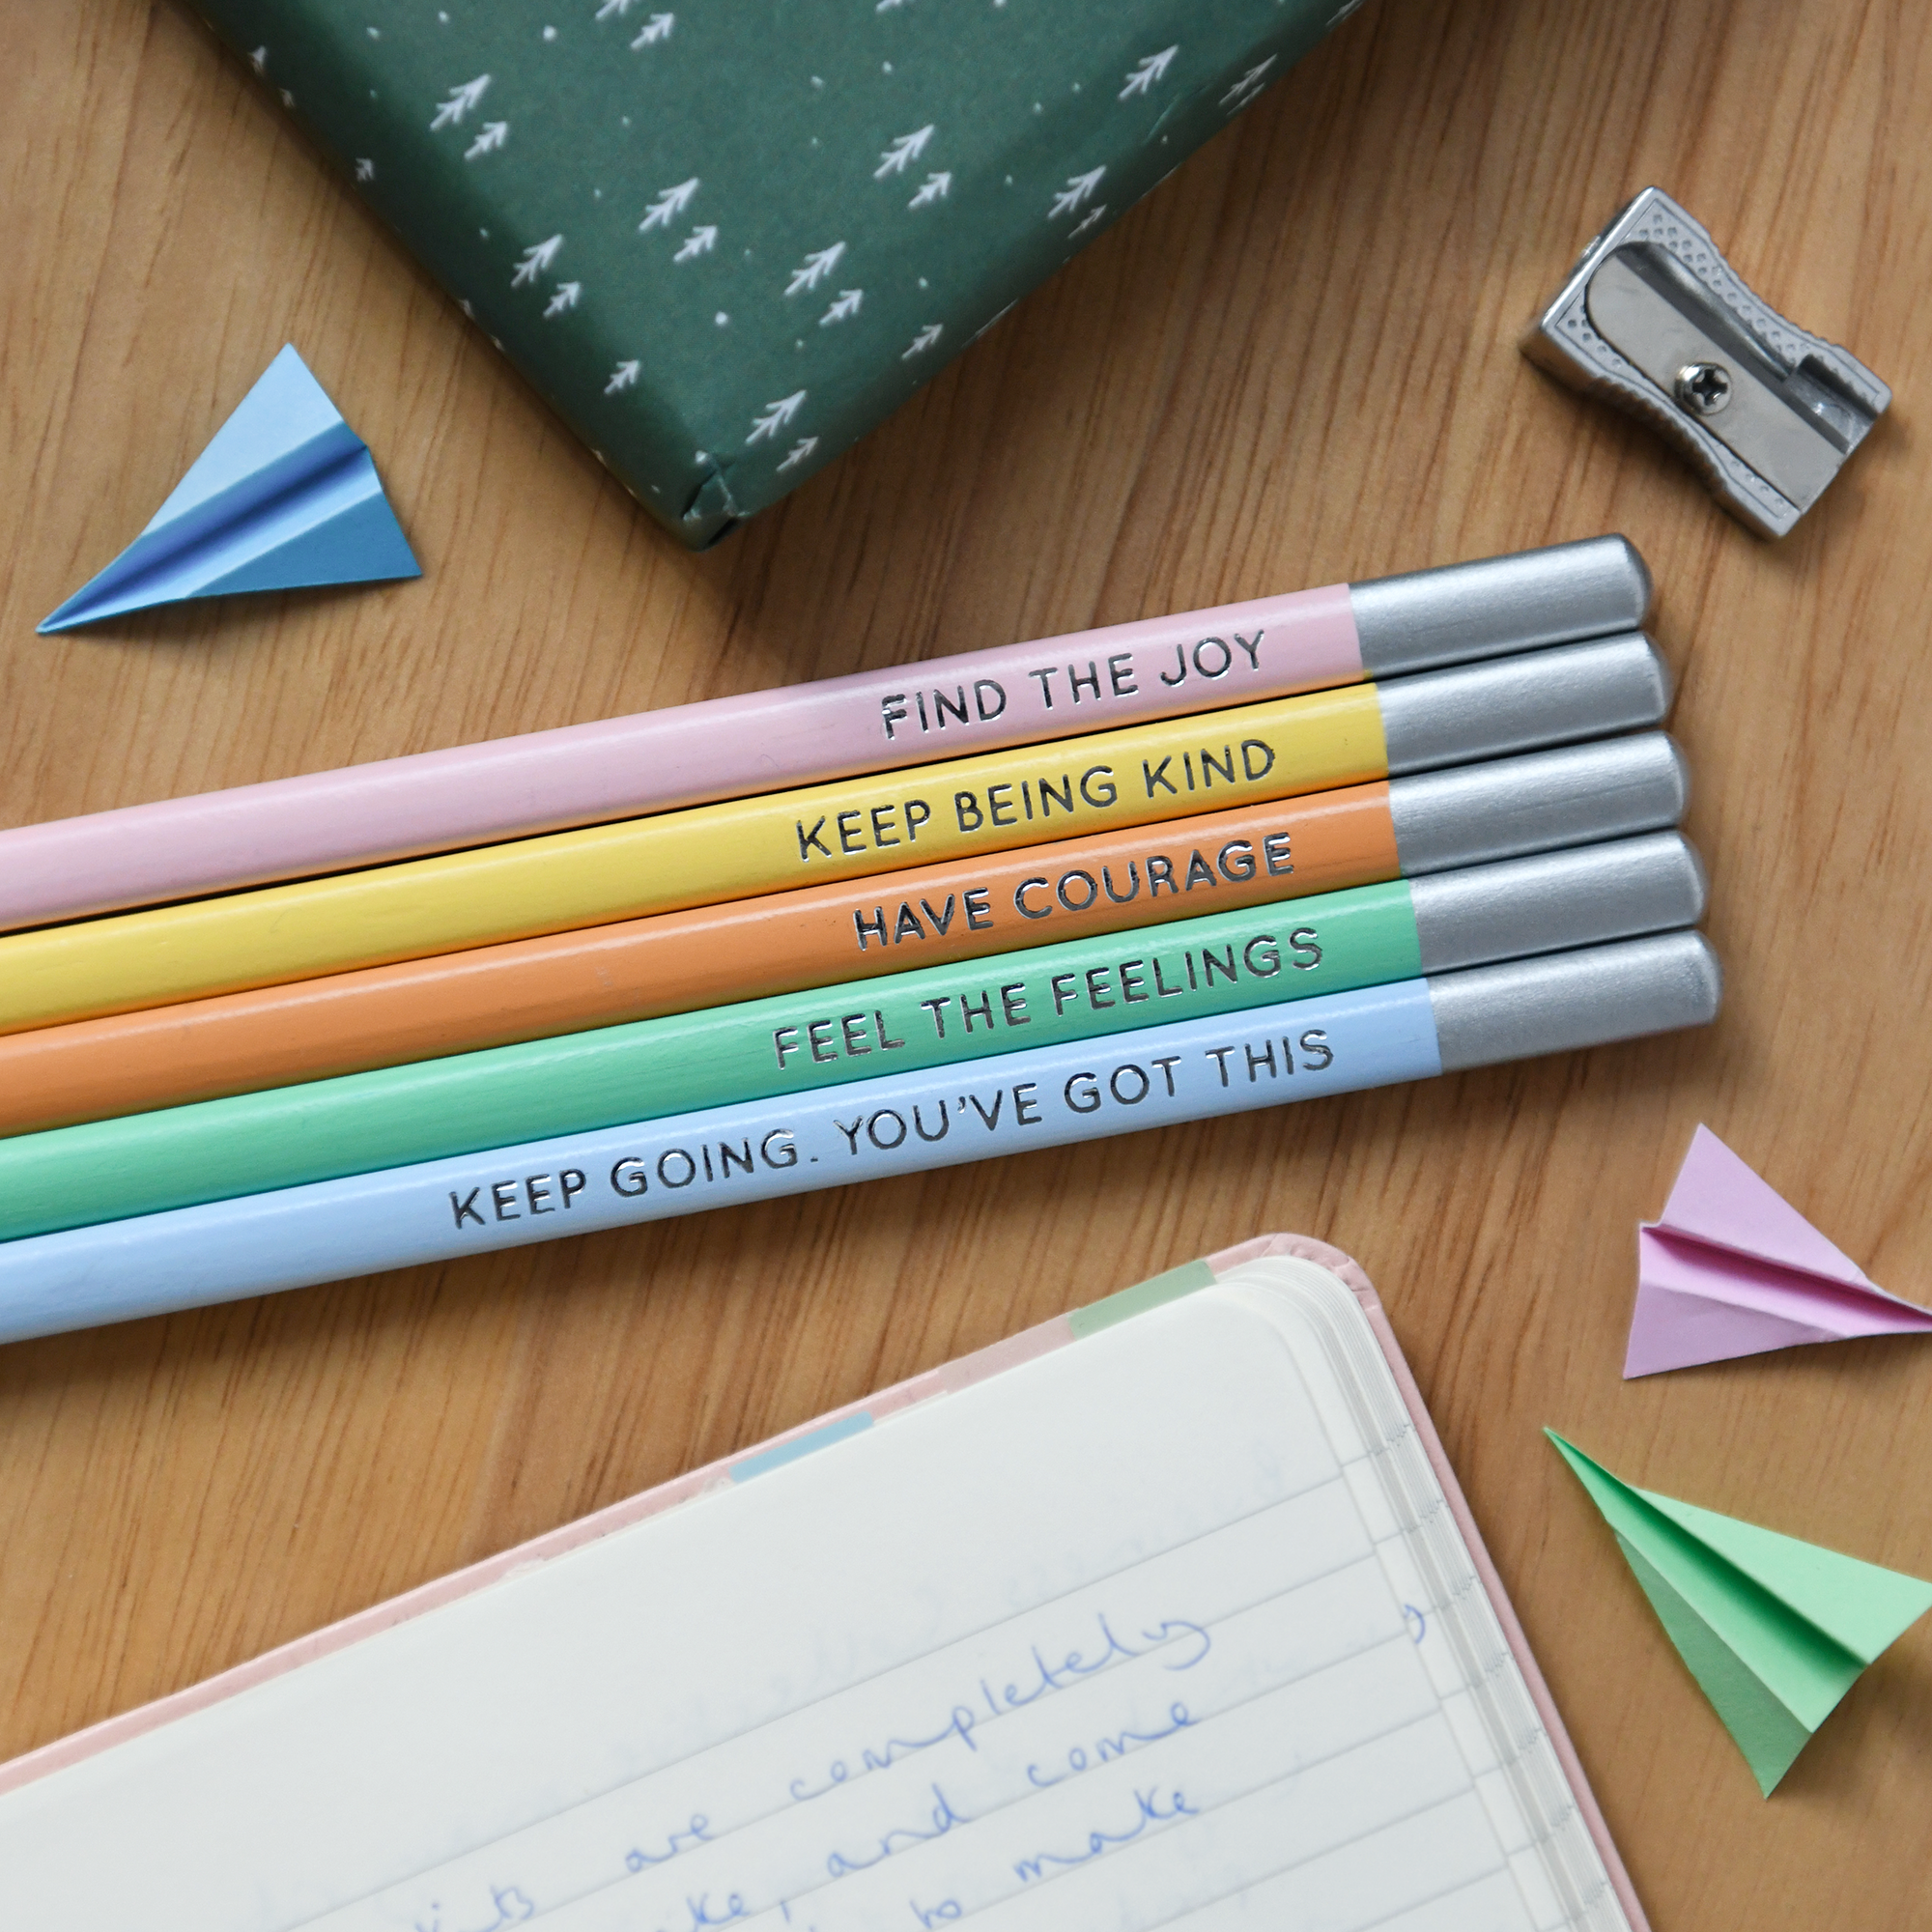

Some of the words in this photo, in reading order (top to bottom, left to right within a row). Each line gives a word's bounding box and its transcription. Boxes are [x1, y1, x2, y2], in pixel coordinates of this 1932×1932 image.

[880, 678, 1008, 741] FIND
[1028, 652, 1140, 711] THE
[1159, 628, 1265, 688] JOY
[795, 798, 932, 863] KEEP
[953, 764, 1119, 834] BEING
[1141, 738, 1276, 800] KIND
[853, 885, 995, 952] HAVE
[1012, 831, 1295, 921] COURAGE
[772, 1009, 907, 1071] FEEL
[920, 981, 1033, 1040] THE
[1050, 925, 1324, 1017] FEELINGS
[447, 1167, 587, 1231] KEEP
[609, 1127, 819, 1199] GOING.
[832, 1081, 1044, 1156] YOU'VE
[1064, 1054, 1183, 1115] GOT
[1204, 1028, 1335, 1089] THIS
[624, 1812, 716, 1874] are
[789, 1611, 1213, 1803] completely
[826, 1781, 970, 1879] and
[1026, 1700, 1205, 1789] come
[1012, 1785, 1200, 1884] make
